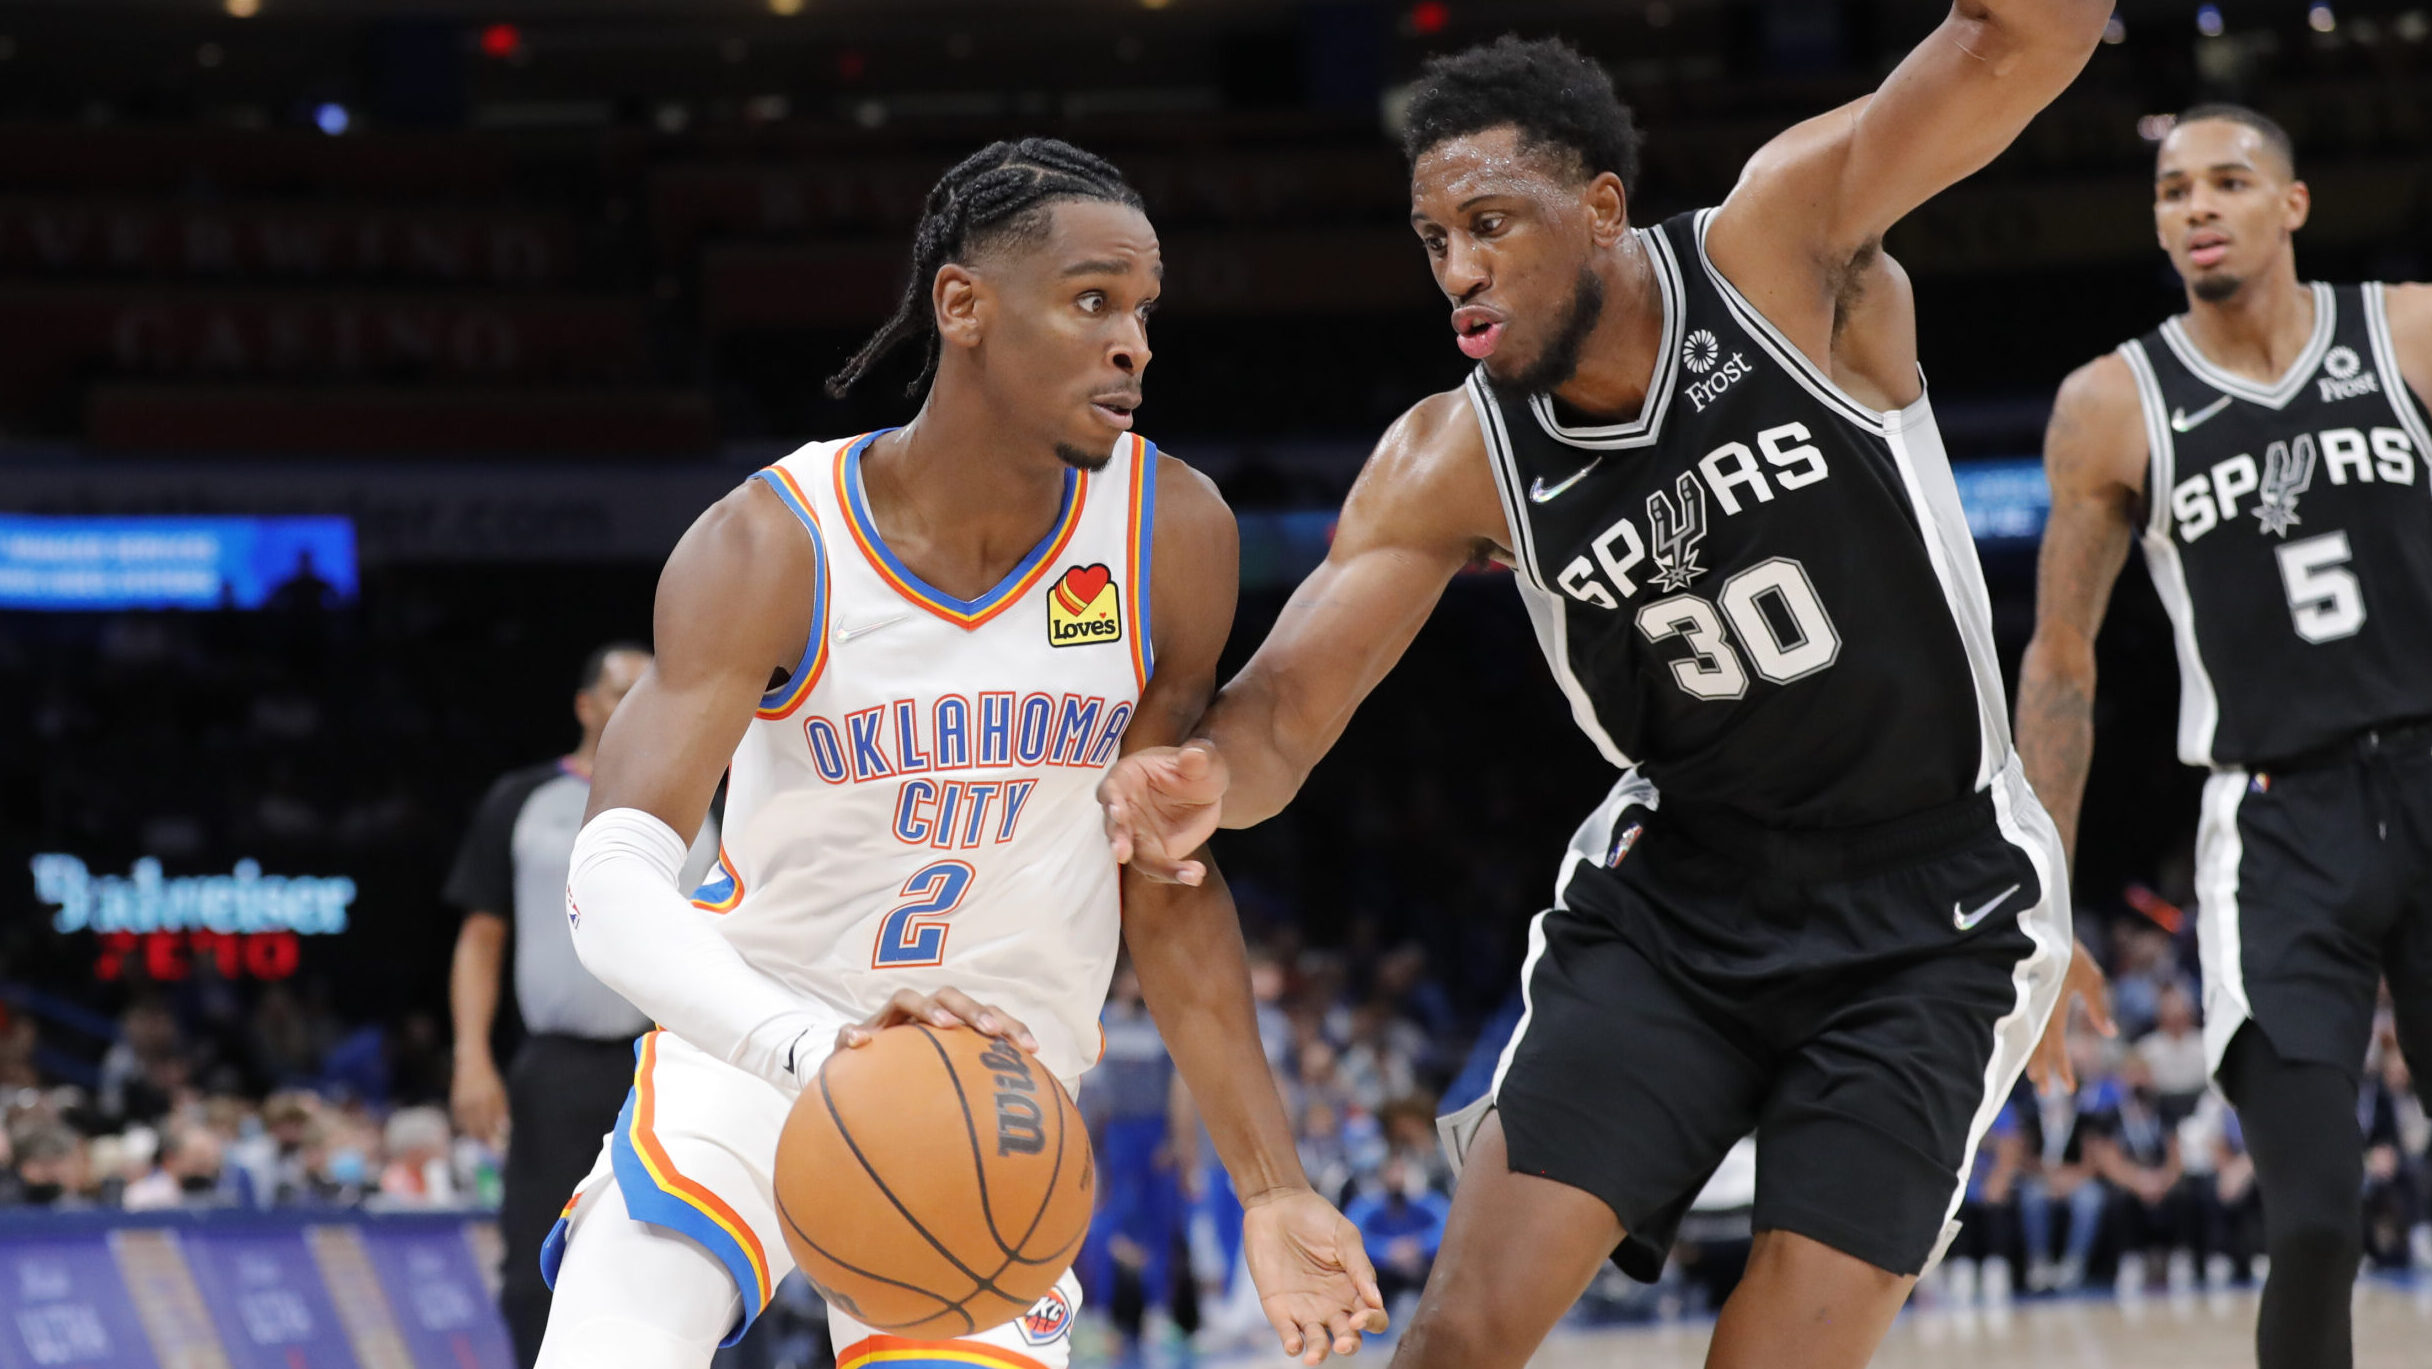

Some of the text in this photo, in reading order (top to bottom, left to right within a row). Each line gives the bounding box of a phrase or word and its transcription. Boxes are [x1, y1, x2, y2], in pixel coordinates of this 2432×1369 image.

[1685, 351, 1753, 413] Frost
[2317, 371, 2379, 402] Frost
[1557, 421, 1829, 610] SPURS
[2171, 427, 2415, 543] SPURS
[1634, 556, 1842, 700] 30
[2274, 529, 2367, 645] 5
[803, 691, 1133, 785] OKLAHOMA
[892, 777, 1040, 850] CITY
[871, 859, 976, 970] 2
